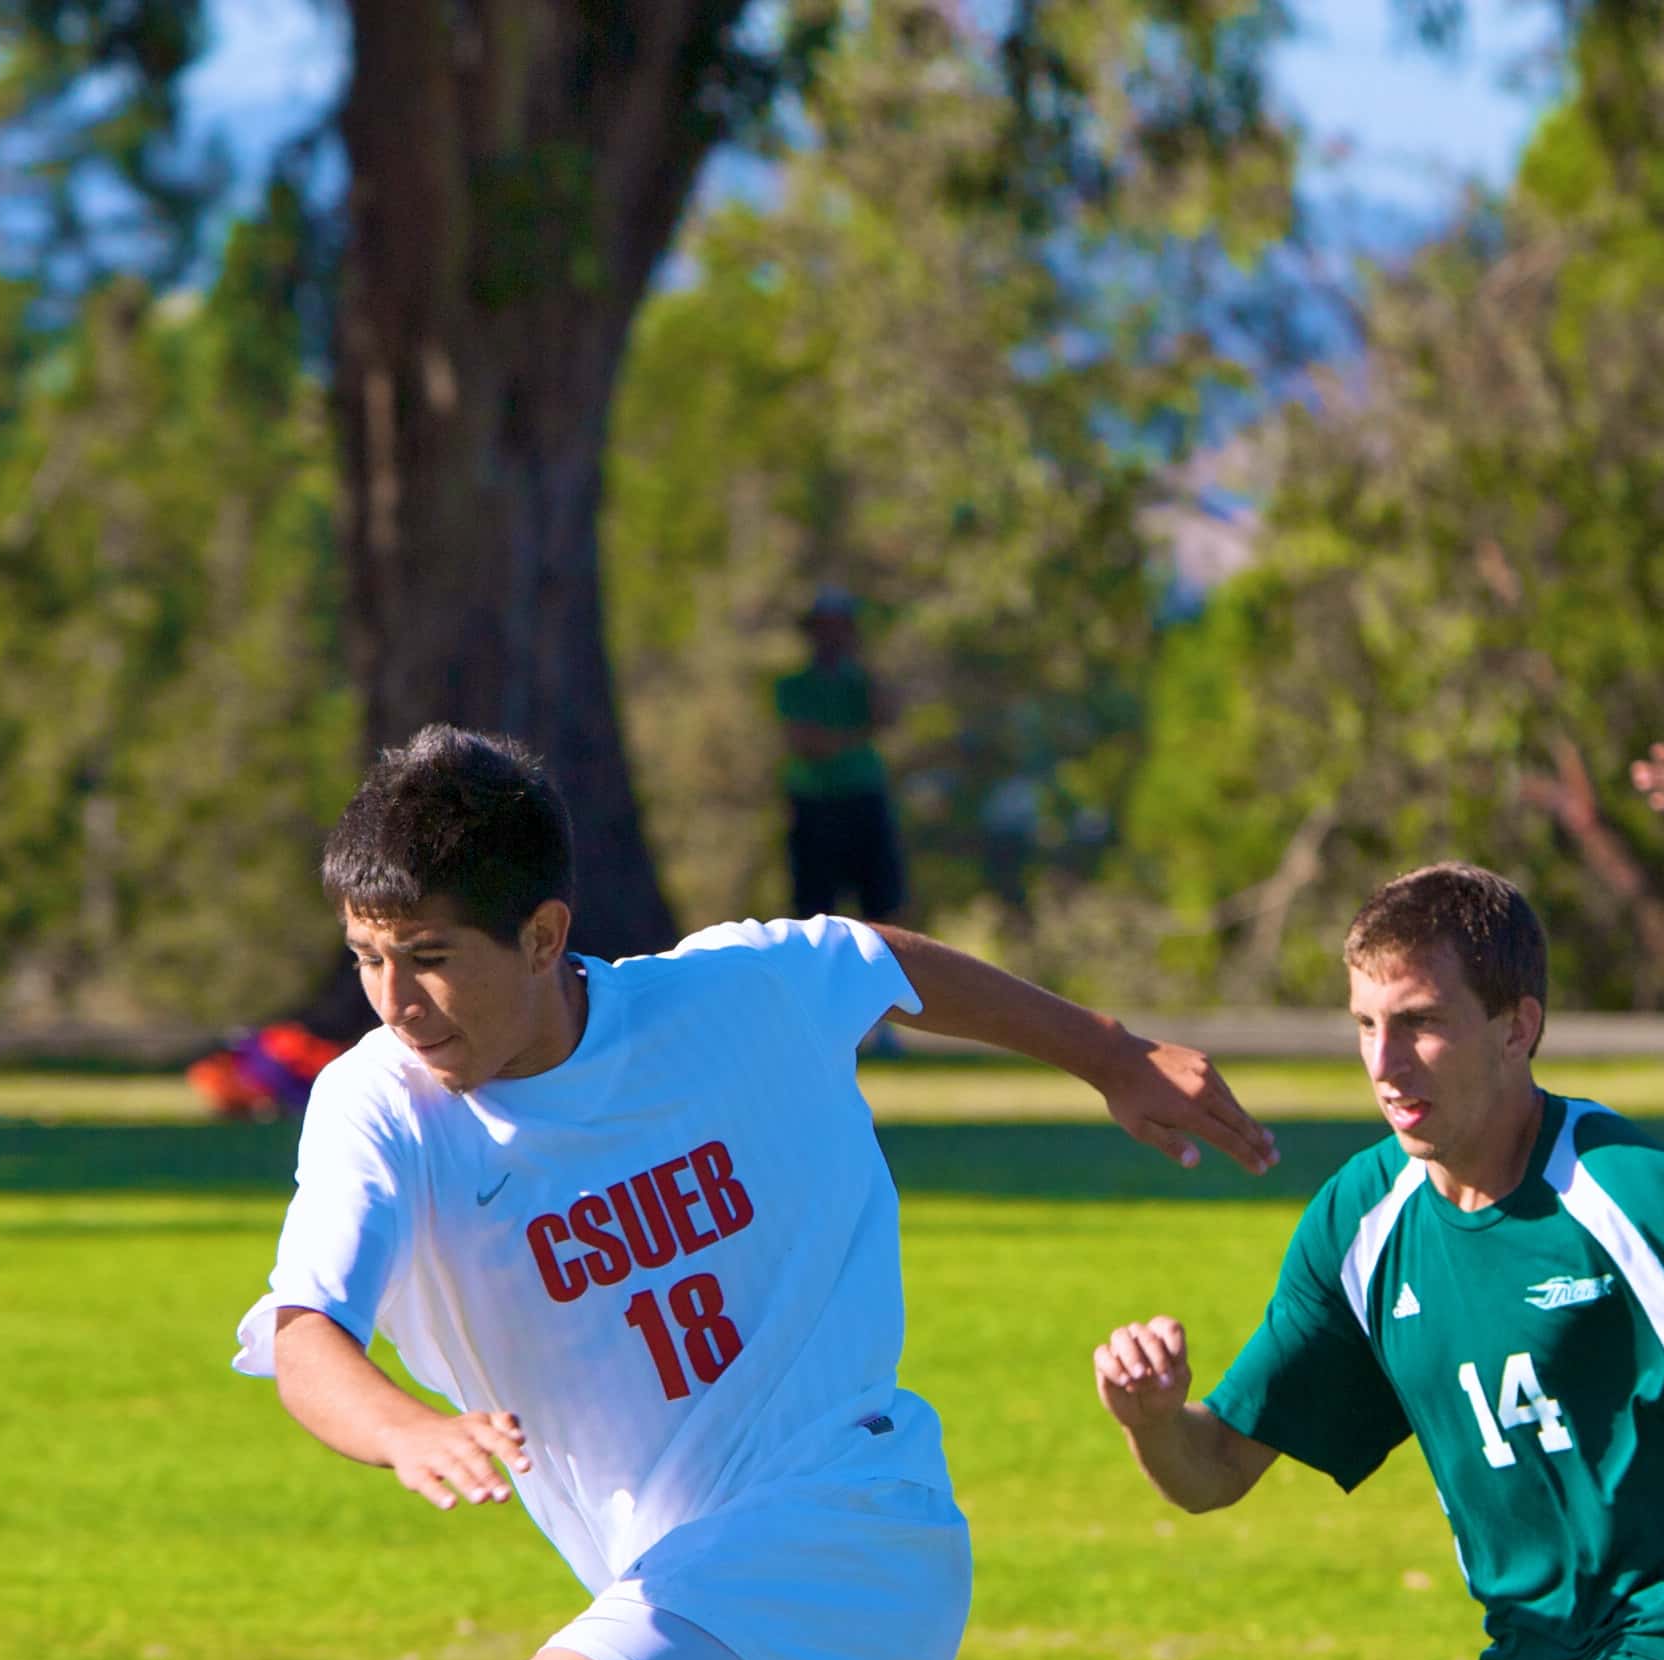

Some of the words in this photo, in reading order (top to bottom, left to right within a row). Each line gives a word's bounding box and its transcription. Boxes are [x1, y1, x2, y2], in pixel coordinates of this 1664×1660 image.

[526, 1141, 754, 1303] CSUEB
[624, 1273, 744, 1400] 18
[1458, 1352, 1573, 1469] 14
